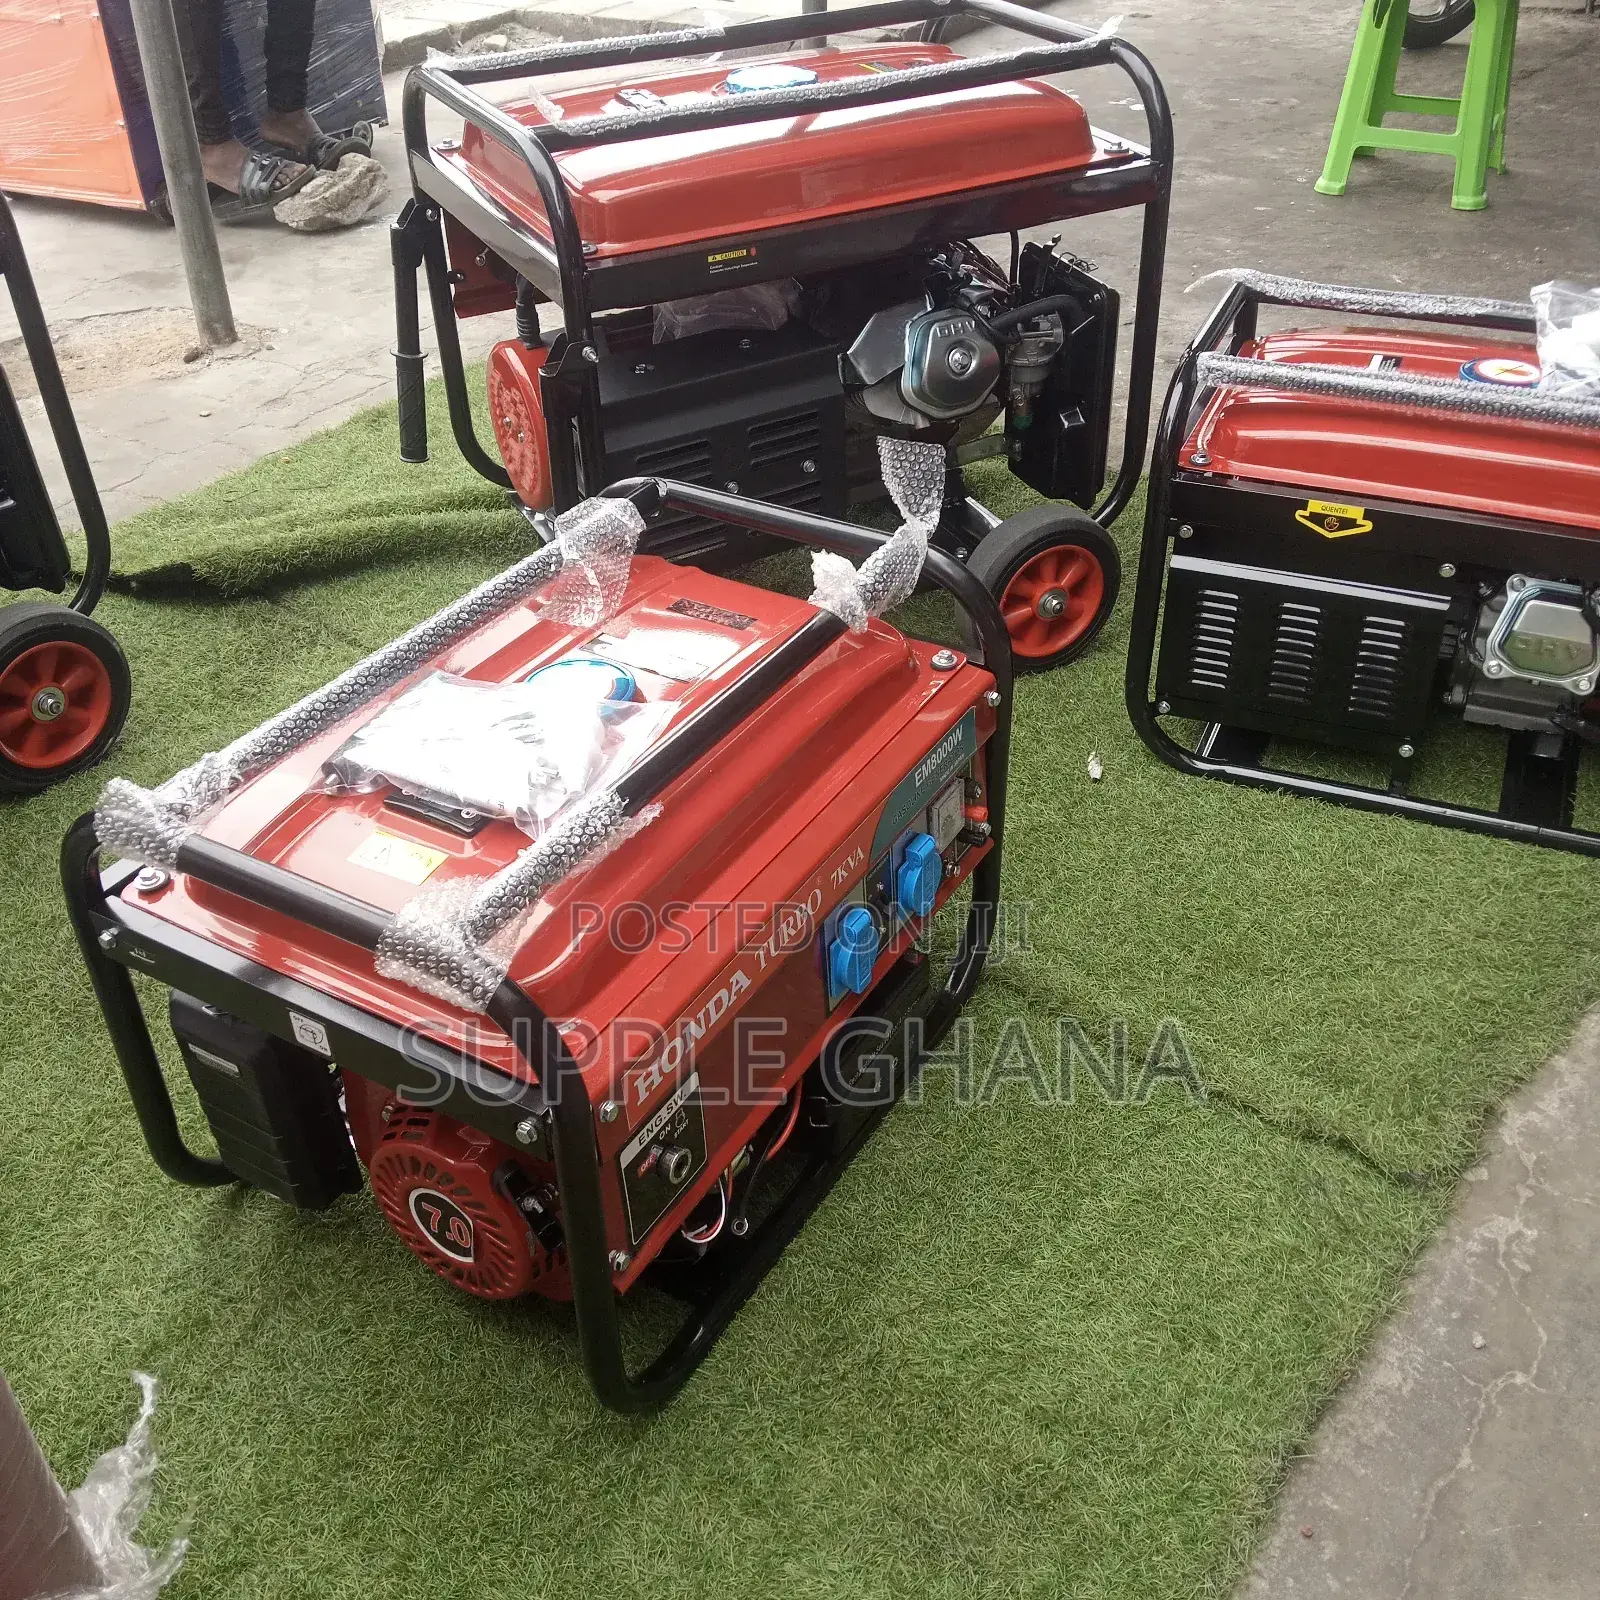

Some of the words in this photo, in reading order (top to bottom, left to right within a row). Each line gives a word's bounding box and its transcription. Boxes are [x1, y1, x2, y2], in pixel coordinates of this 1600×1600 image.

[720, 249, 745, 260] CAUTION
[914, 724, 963, 788] EM8000W
[633, 968, 753, 1107] HONDA
[754, 888, 823, 972] TURBO
[829, 845, 865, 890] 7KVA
[637, 1089, 687, 1147] ENG.SW.
[658, 1123, 671, 1141] ON
[674, 1118, 689, 1139] START
[640, 1155, 654, 1172] OFF
[421, 1201, 471, 1249] 7.0
